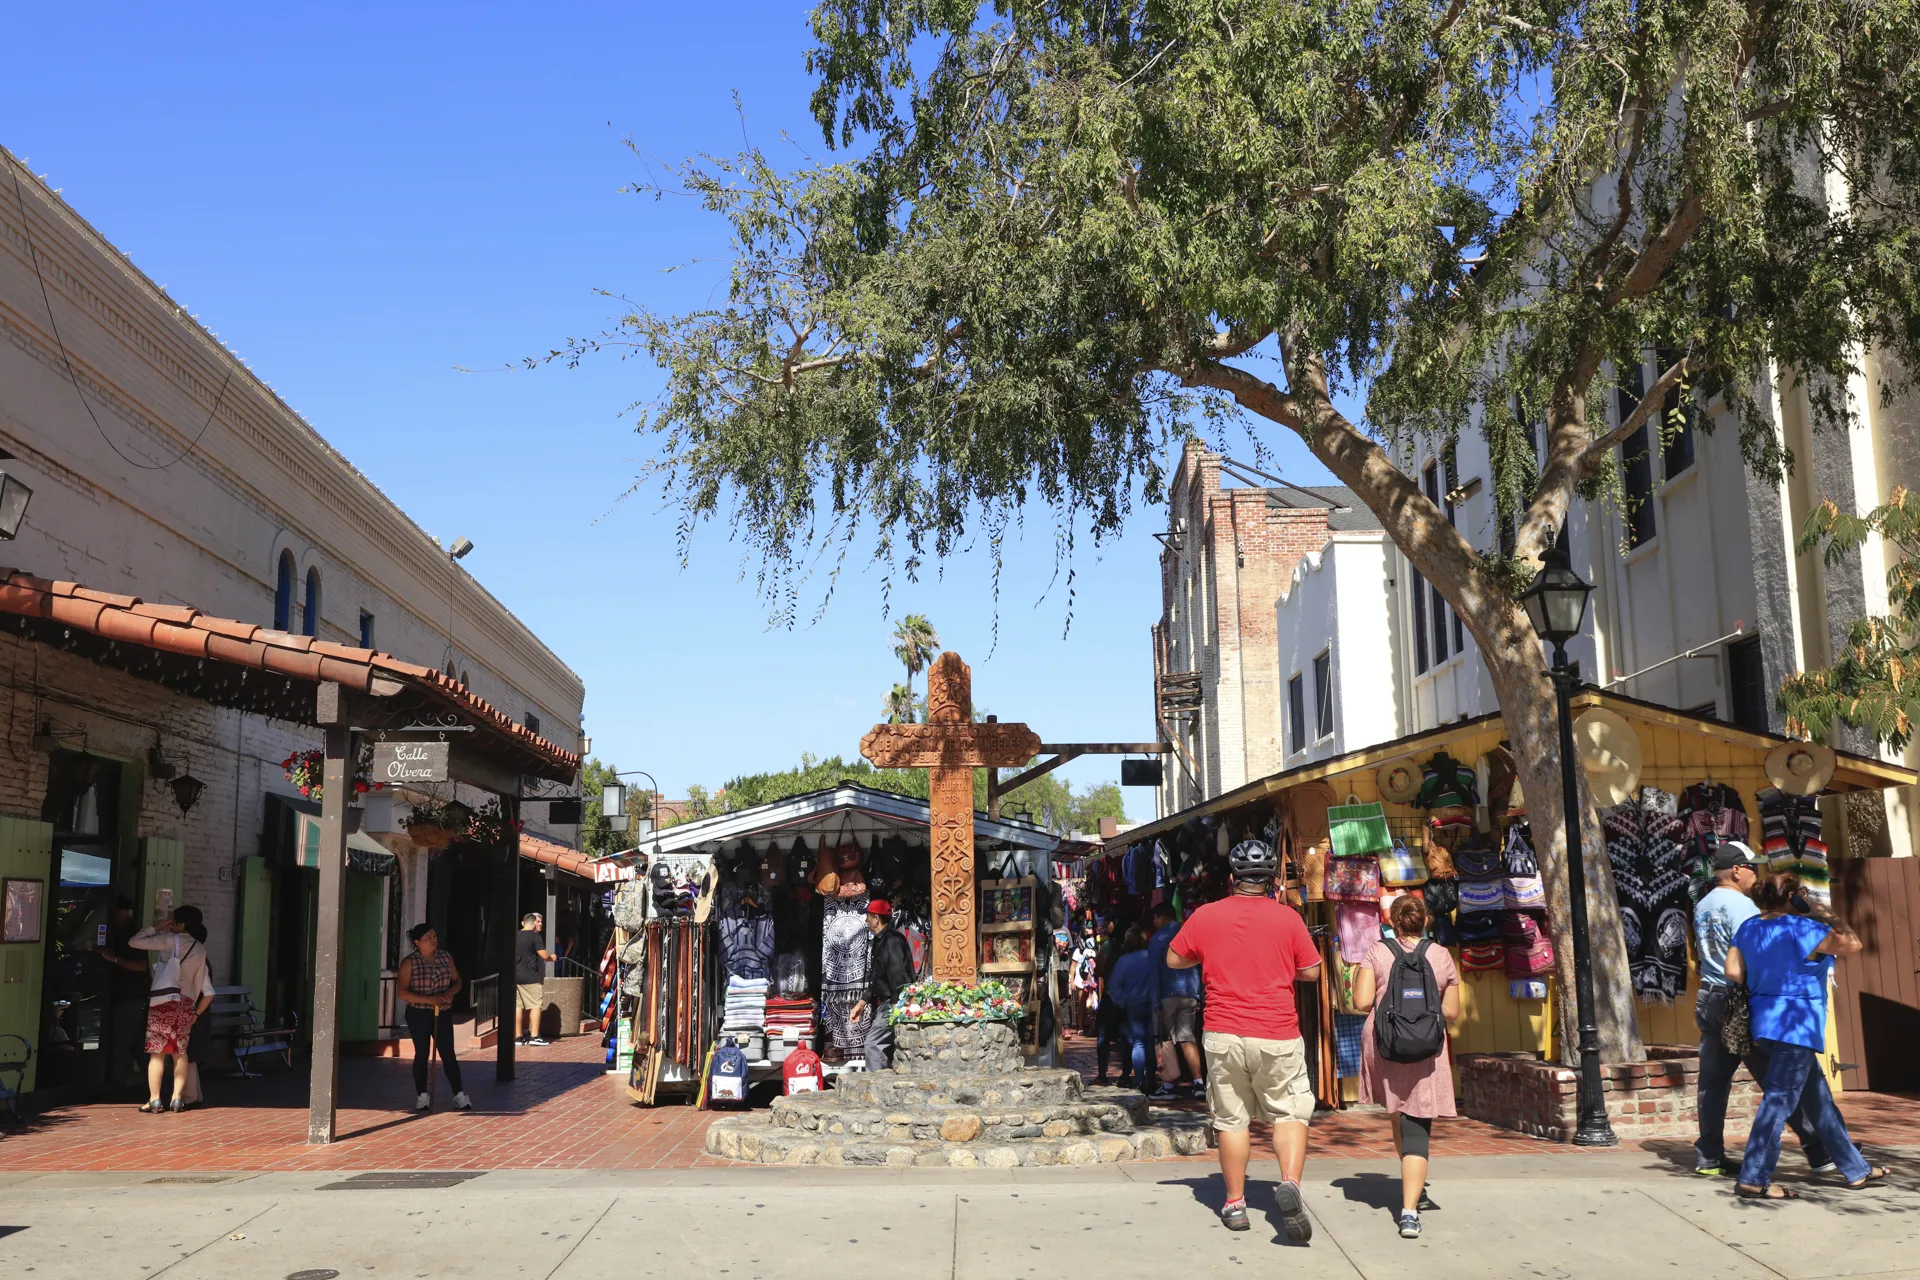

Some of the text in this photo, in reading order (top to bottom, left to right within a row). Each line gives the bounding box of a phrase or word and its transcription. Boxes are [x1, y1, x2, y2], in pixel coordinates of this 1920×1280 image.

[878, 738, 891, 752] DE
[943, 738, 956, 752] DE
[958, 738, 975, 751] LOS
[978, 737, 1022, 750] ANGELES
[395, 746, 428, 760] Calle
[911, 752, 988, 764] FELIPE DE NEVE
[387, 761, 433, 778] Olvera
[931, 769, 970, 780] SEPTEMBER
[935, 781, 968, 792] FOURTH
[941, 793, 962, 804] 1781
[598, 863, 633, 882] ATM
